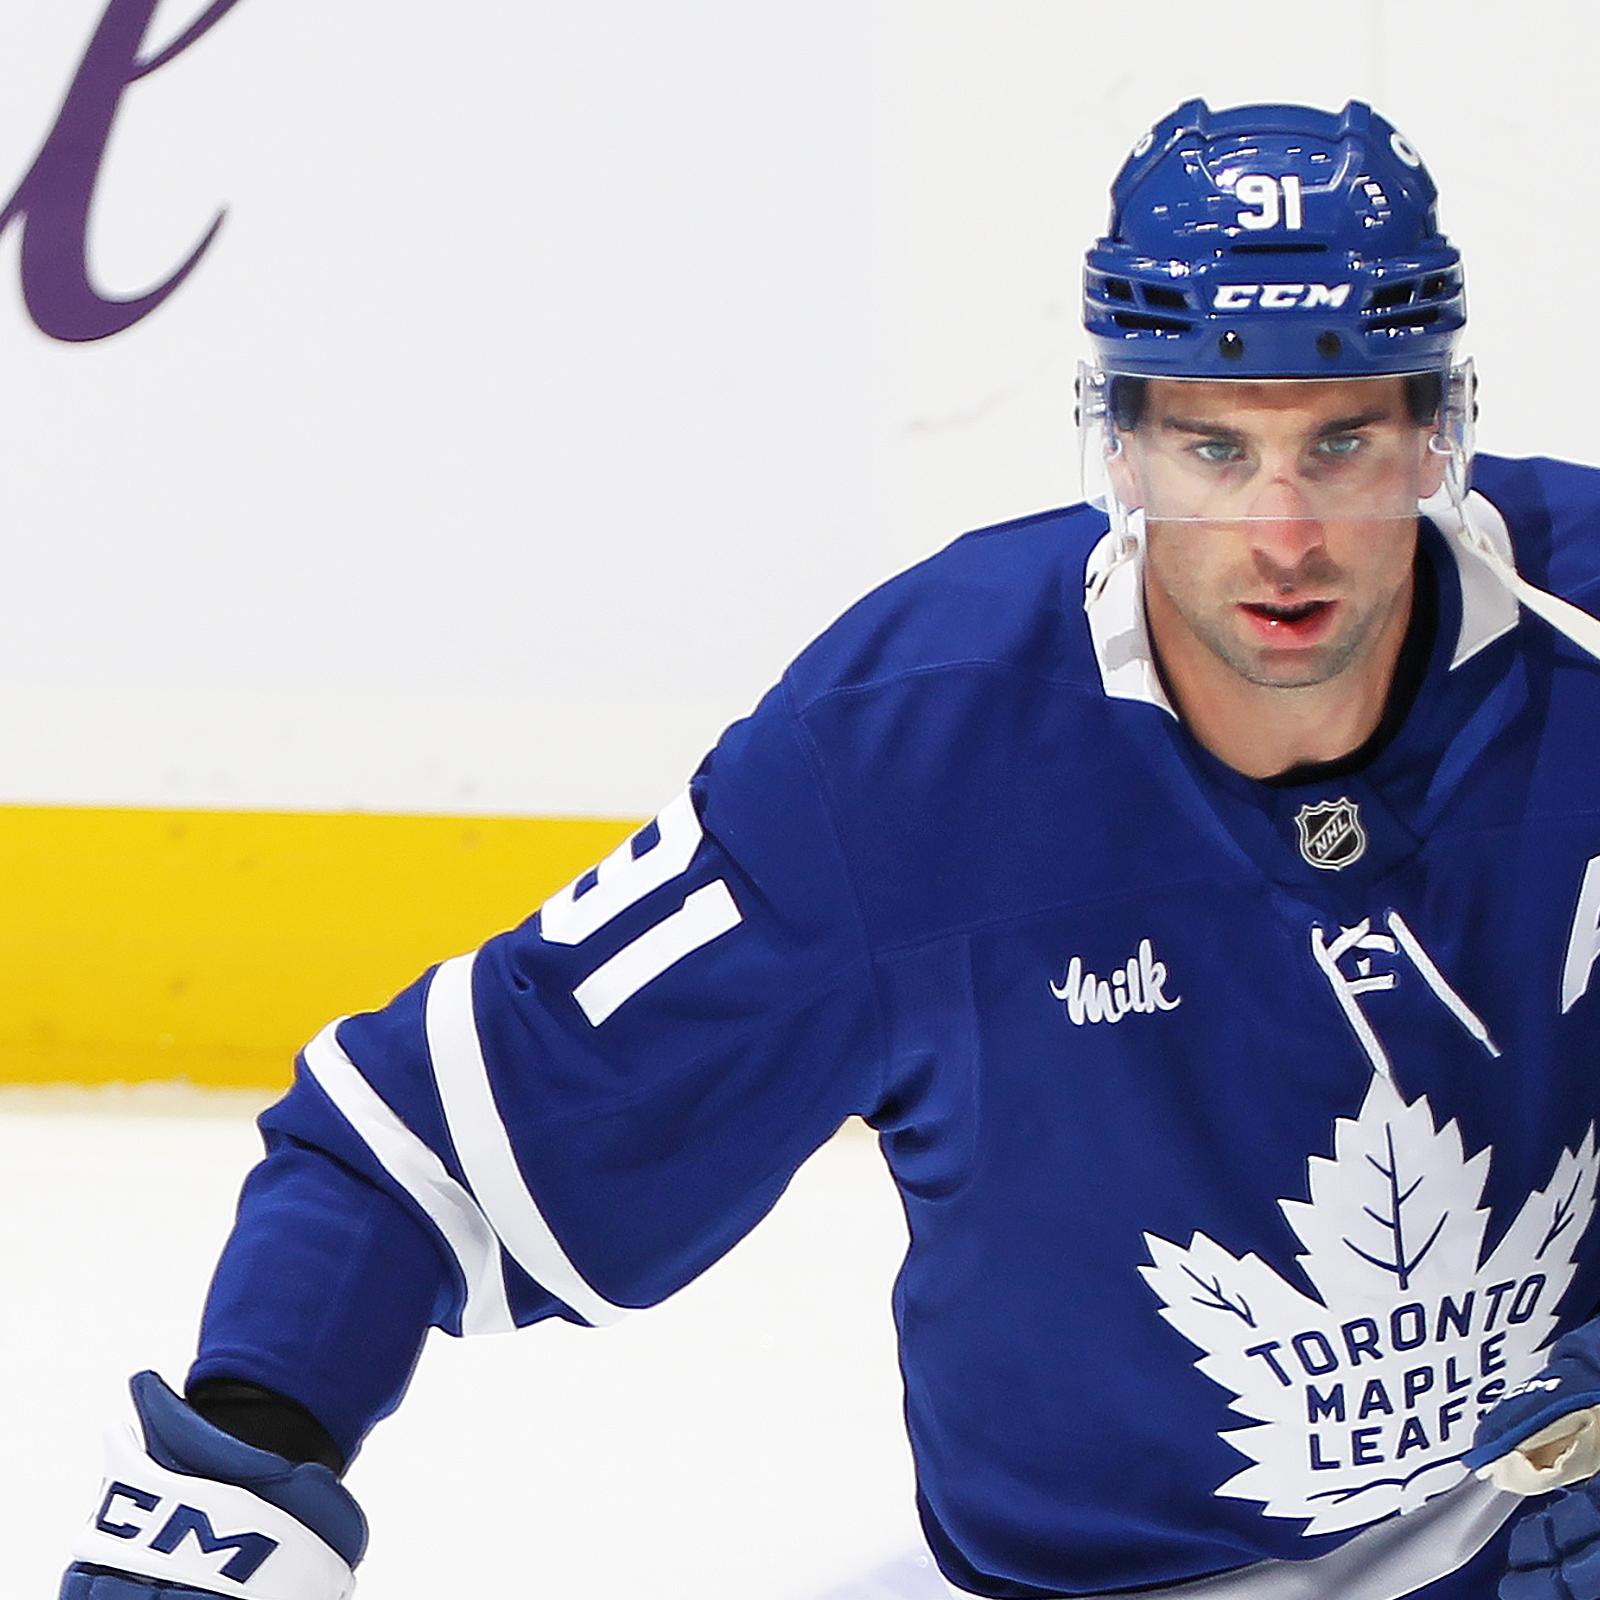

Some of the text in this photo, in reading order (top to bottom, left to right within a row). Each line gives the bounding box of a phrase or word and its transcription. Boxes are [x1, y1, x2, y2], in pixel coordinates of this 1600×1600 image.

[1235, 174, 1302, 231] 91
[1212, 282, 1351, 309] CCM
[1314, 817, 1349, 857] NHL
[1050, 936, 1181, 1027] Milk
[1245, 1273, 1547, 1387] TORONTO
[1305, 1331, 1507, 1424] MAPLE
[96, 1480, 280, 1585] CM
